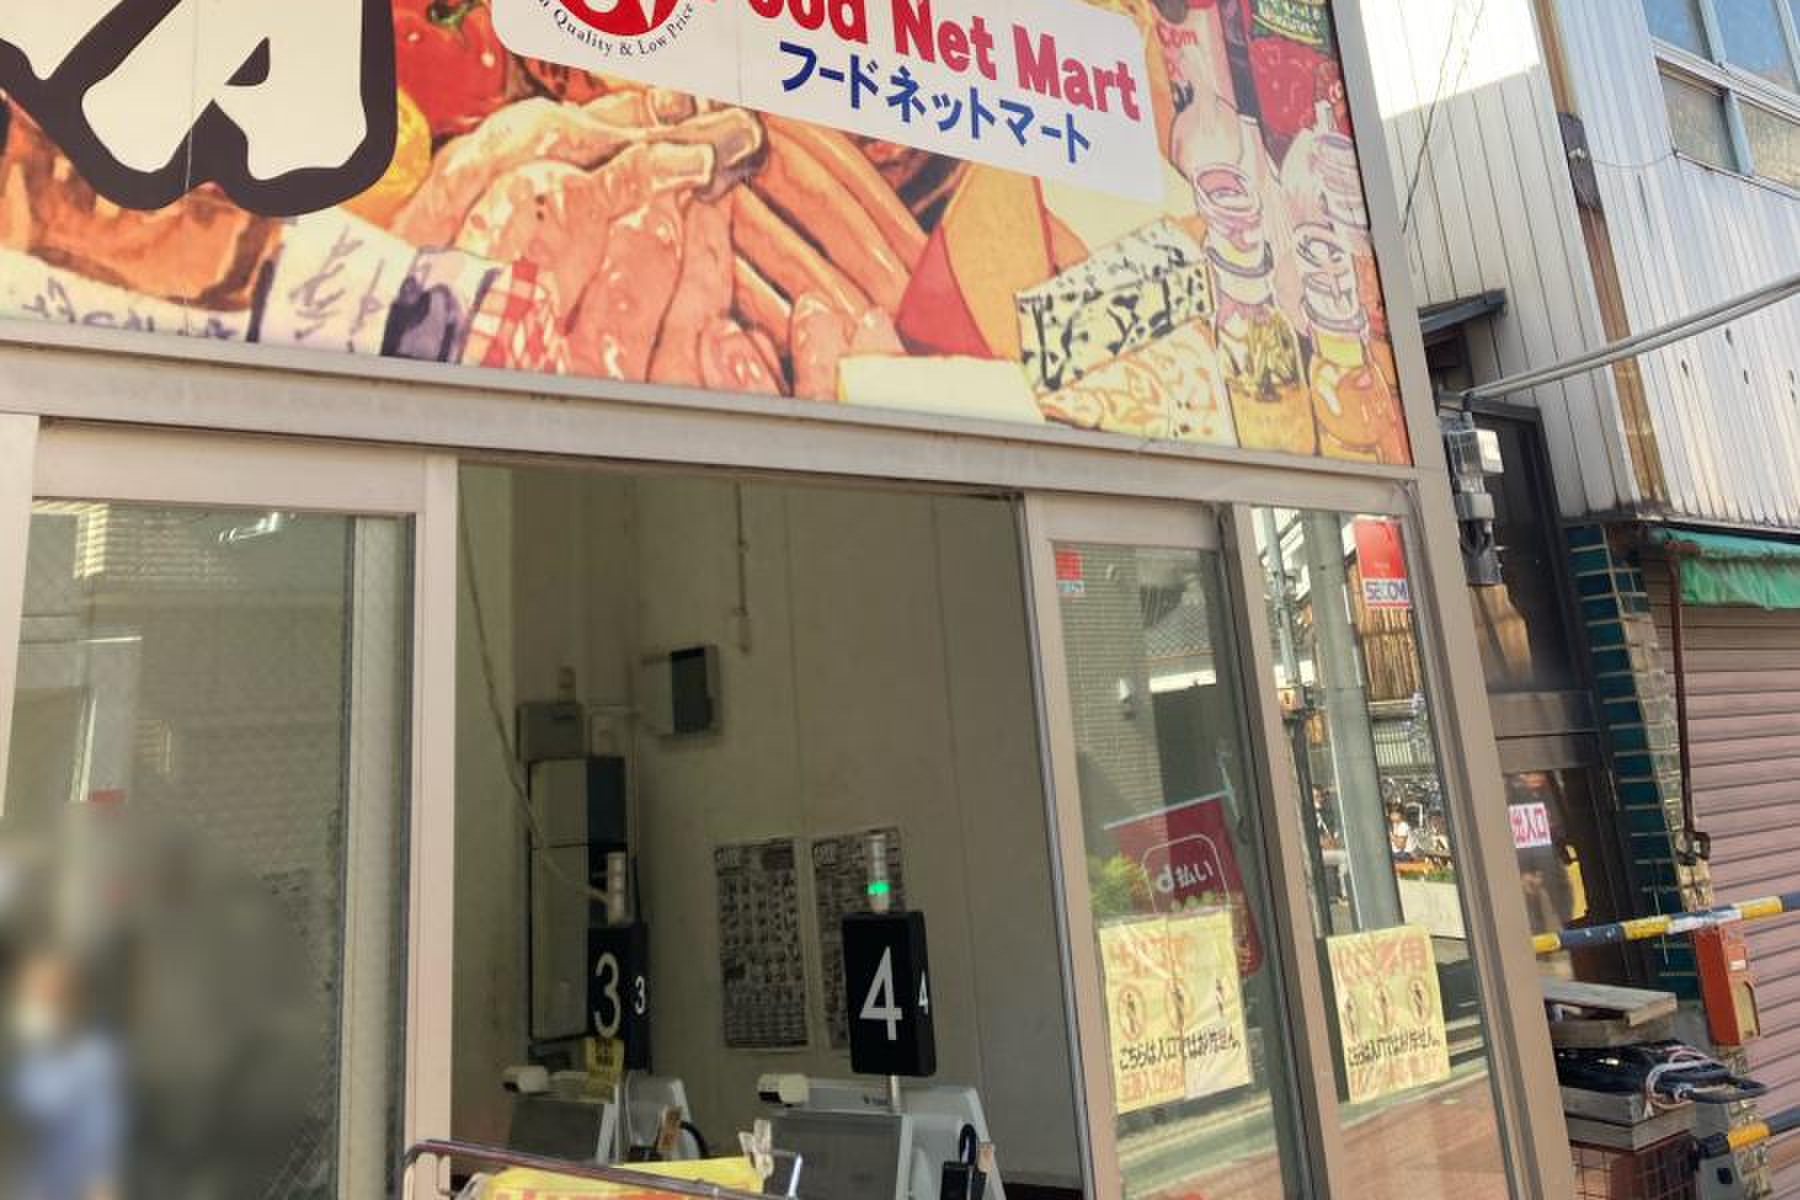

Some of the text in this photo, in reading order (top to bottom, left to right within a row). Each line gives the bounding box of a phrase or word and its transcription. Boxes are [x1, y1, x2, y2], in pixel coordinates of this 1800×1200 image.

[553, 8, 613, 56] Quality
[619, 42, 634, 56] &
[638, 35, 669, 56] Low
[666, 2, 694, 40] Price
[1011, 23, 1141, 121] Mart
[779, 41, 1091, 164] フードネットマート
[593, 952, 622, 1038] 3
[634, 975, 646, 1015] 3
[859, 946, 903, 1041] 4
[918, 970, 929, 1015] 4
